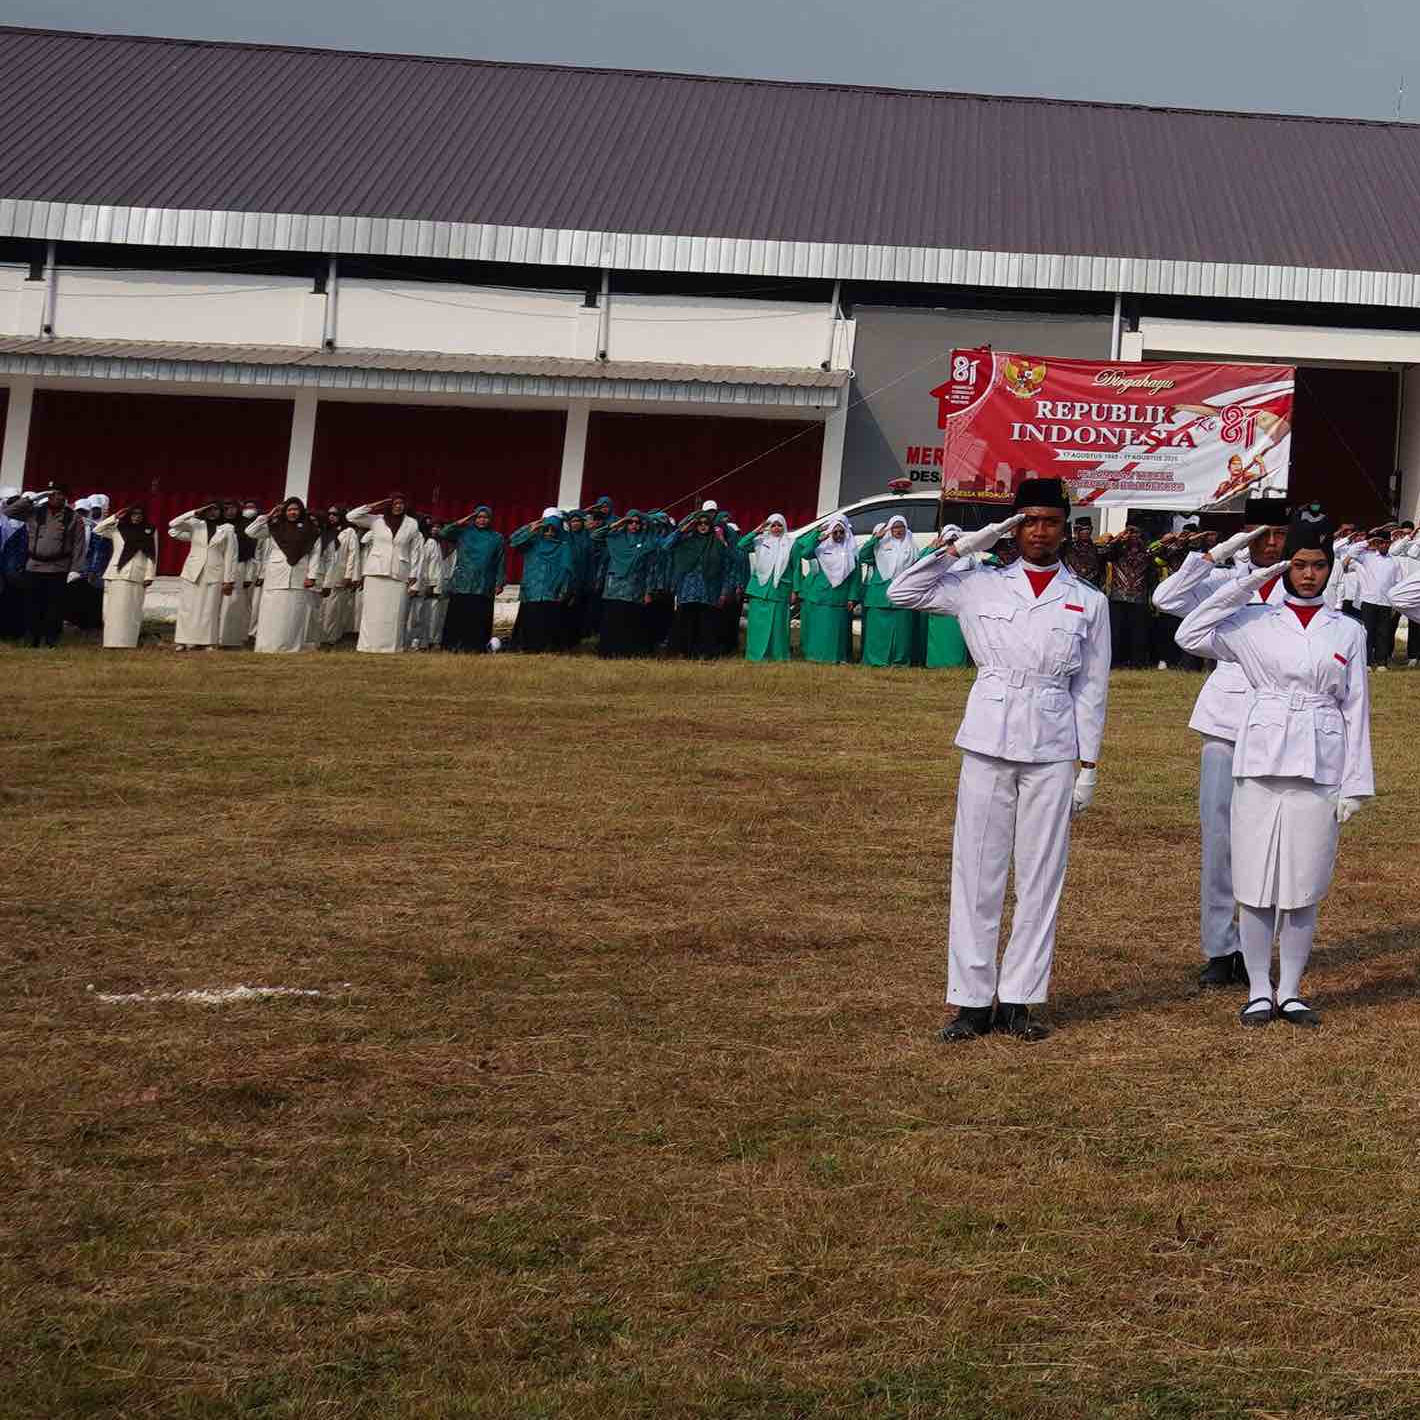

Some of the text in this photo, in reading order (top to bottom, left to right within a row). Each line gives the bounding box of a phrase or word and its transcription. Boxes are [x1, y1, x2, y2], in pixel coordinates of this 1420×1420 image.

[1092, 369, 1175, 395] Dirgahayu
[1035, 400, 1174, 424] REPUBLIK
[1010, 422, 1199, 448] INDONESIA
[1220, 404, 1264, 450] 81
[910, 470, 942, 482] DES
